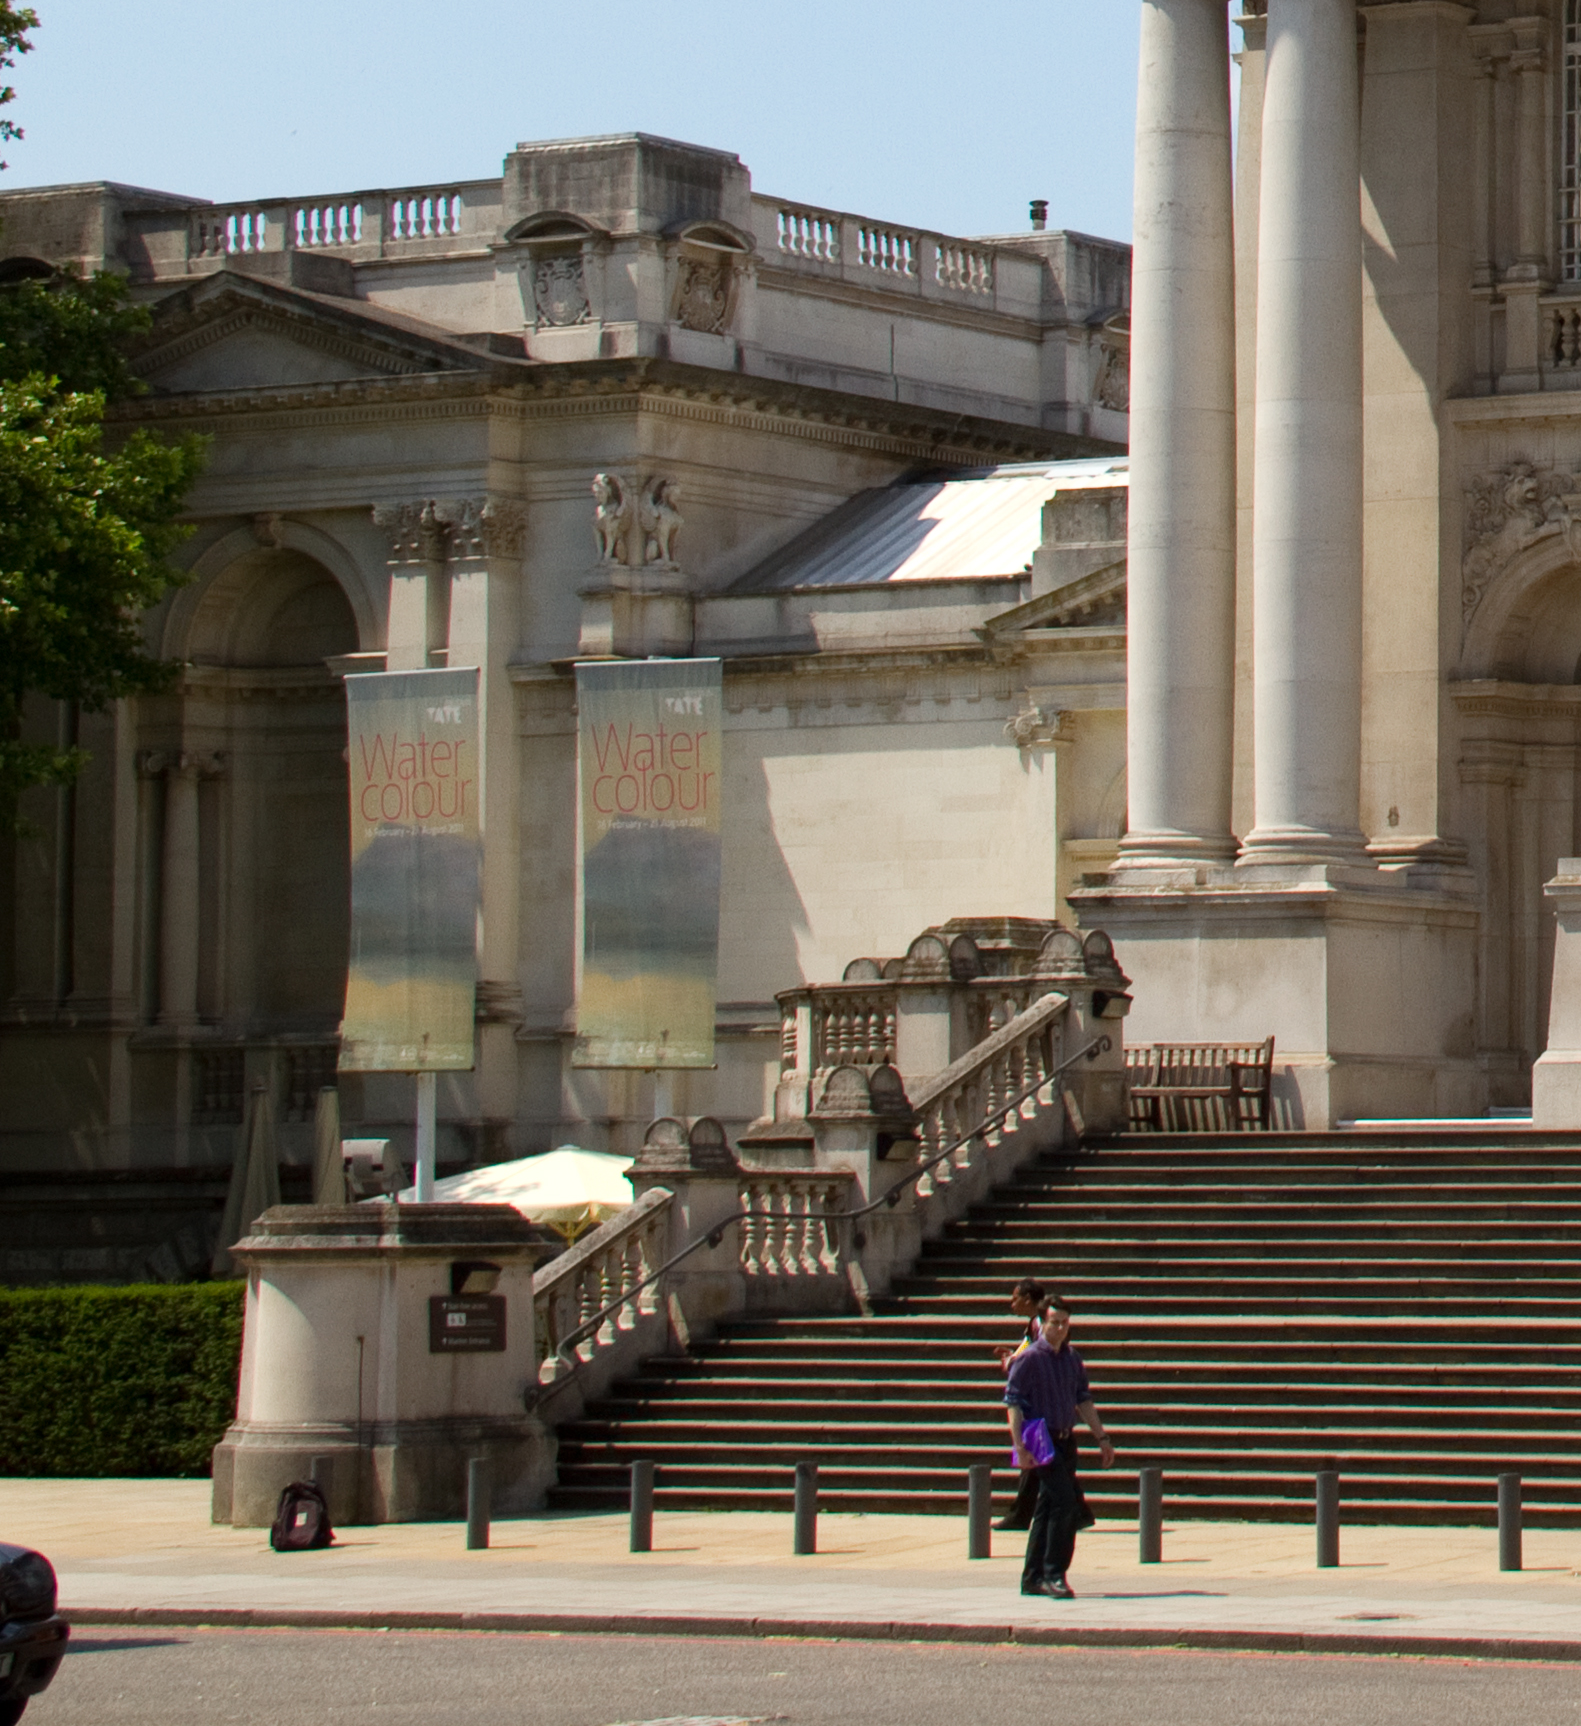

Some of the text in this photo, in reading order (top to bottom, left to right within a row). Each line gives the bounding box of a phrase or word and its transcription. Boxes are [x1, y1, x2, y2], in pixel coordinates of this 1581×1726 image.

[426, 706, 462, 723] TATE
[666, 697, 702, 715] TATE
[360, 732, 466, 781] Water
[592, 722, 708, 772] Water
[361, 768, 472, 821] colour
[593, 759, 715, 813] colour
